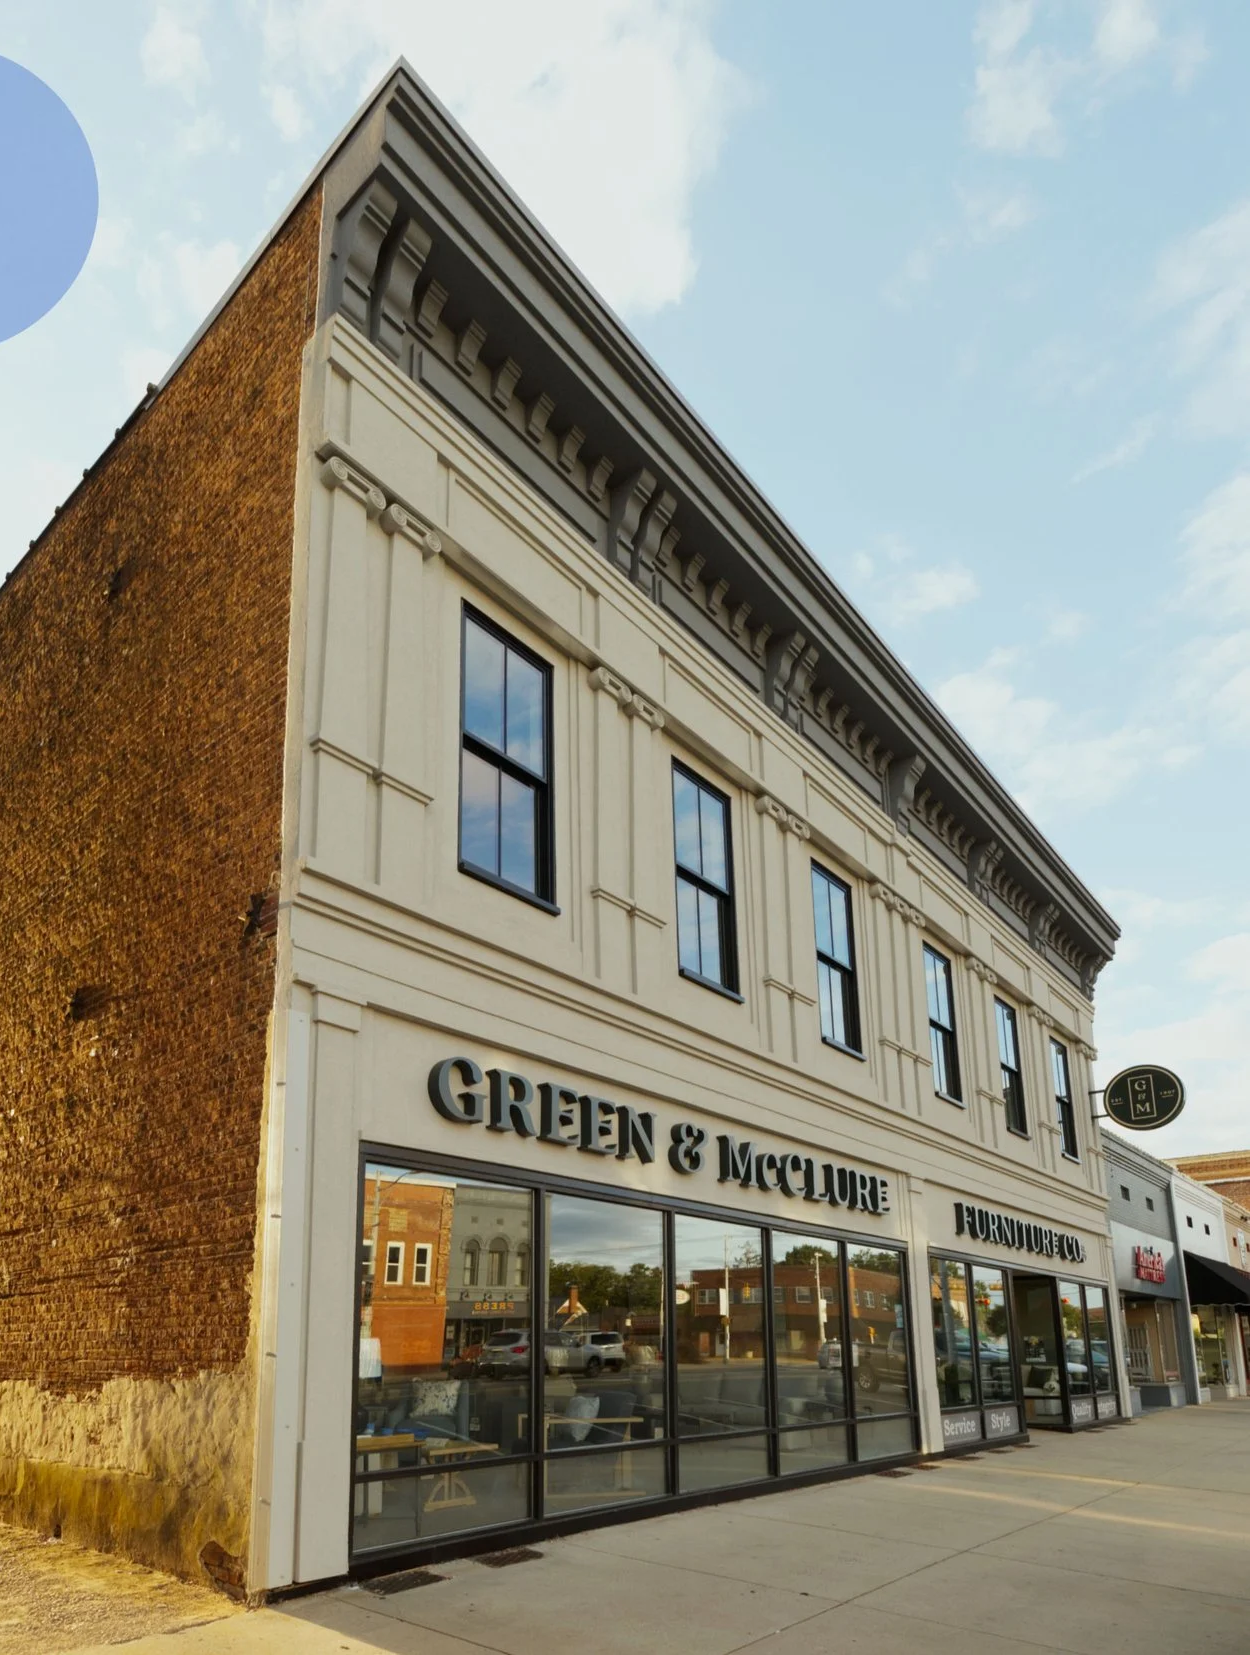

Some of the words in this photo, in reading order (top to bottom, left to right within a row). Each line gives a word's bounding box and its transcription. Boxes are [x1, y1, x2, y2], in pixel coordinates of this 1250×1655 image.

[1134, 1080, 1147, 1091] G
[428, 1056, 656, 1164] GREEN
[668, 1122, 709, 1175] &
[1136, 1102, 1151, 1114] M
[953, 1202, 1059, 1258] FURNITURE
[944, 1417, 976, 1436] Service
[991, 1412, 1011, 1432] Style
